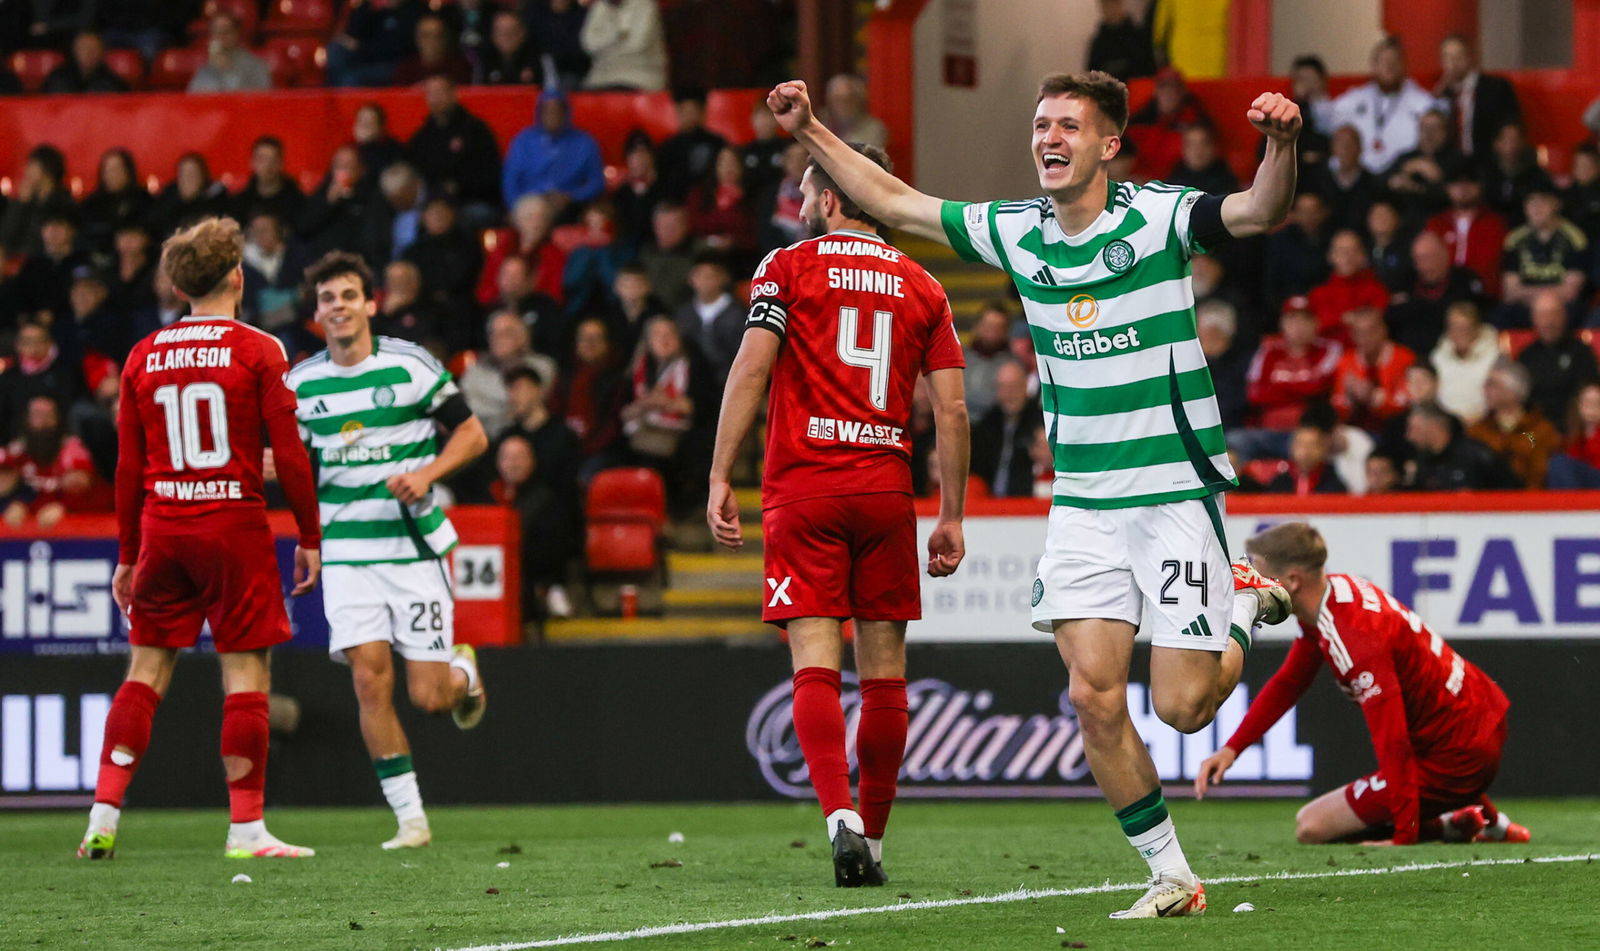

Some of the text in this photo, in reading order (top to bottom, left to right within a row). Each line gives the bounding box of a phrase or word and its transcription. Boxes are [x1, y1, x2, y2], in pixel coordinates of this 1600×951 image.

[817, 241, 900, 263] MAXAMAZE
[827, 267, 905, 298] SHINNIE
[748, 301, 769, 322] C
[1053, 326, 1140, 360] dafabet
[146, 347, 232, 374] CLARKSON
[836, 306, 893, 411] 4
[153, 381, 232, 473] 10
[807, 416, 904, 447] EIS WASTE
[175, 480, 242, 500] WASTE
[460, 557, 496, 586] 36
[1160, 560, 1208, 607] 24
[410, 601, 443, 631] 28
